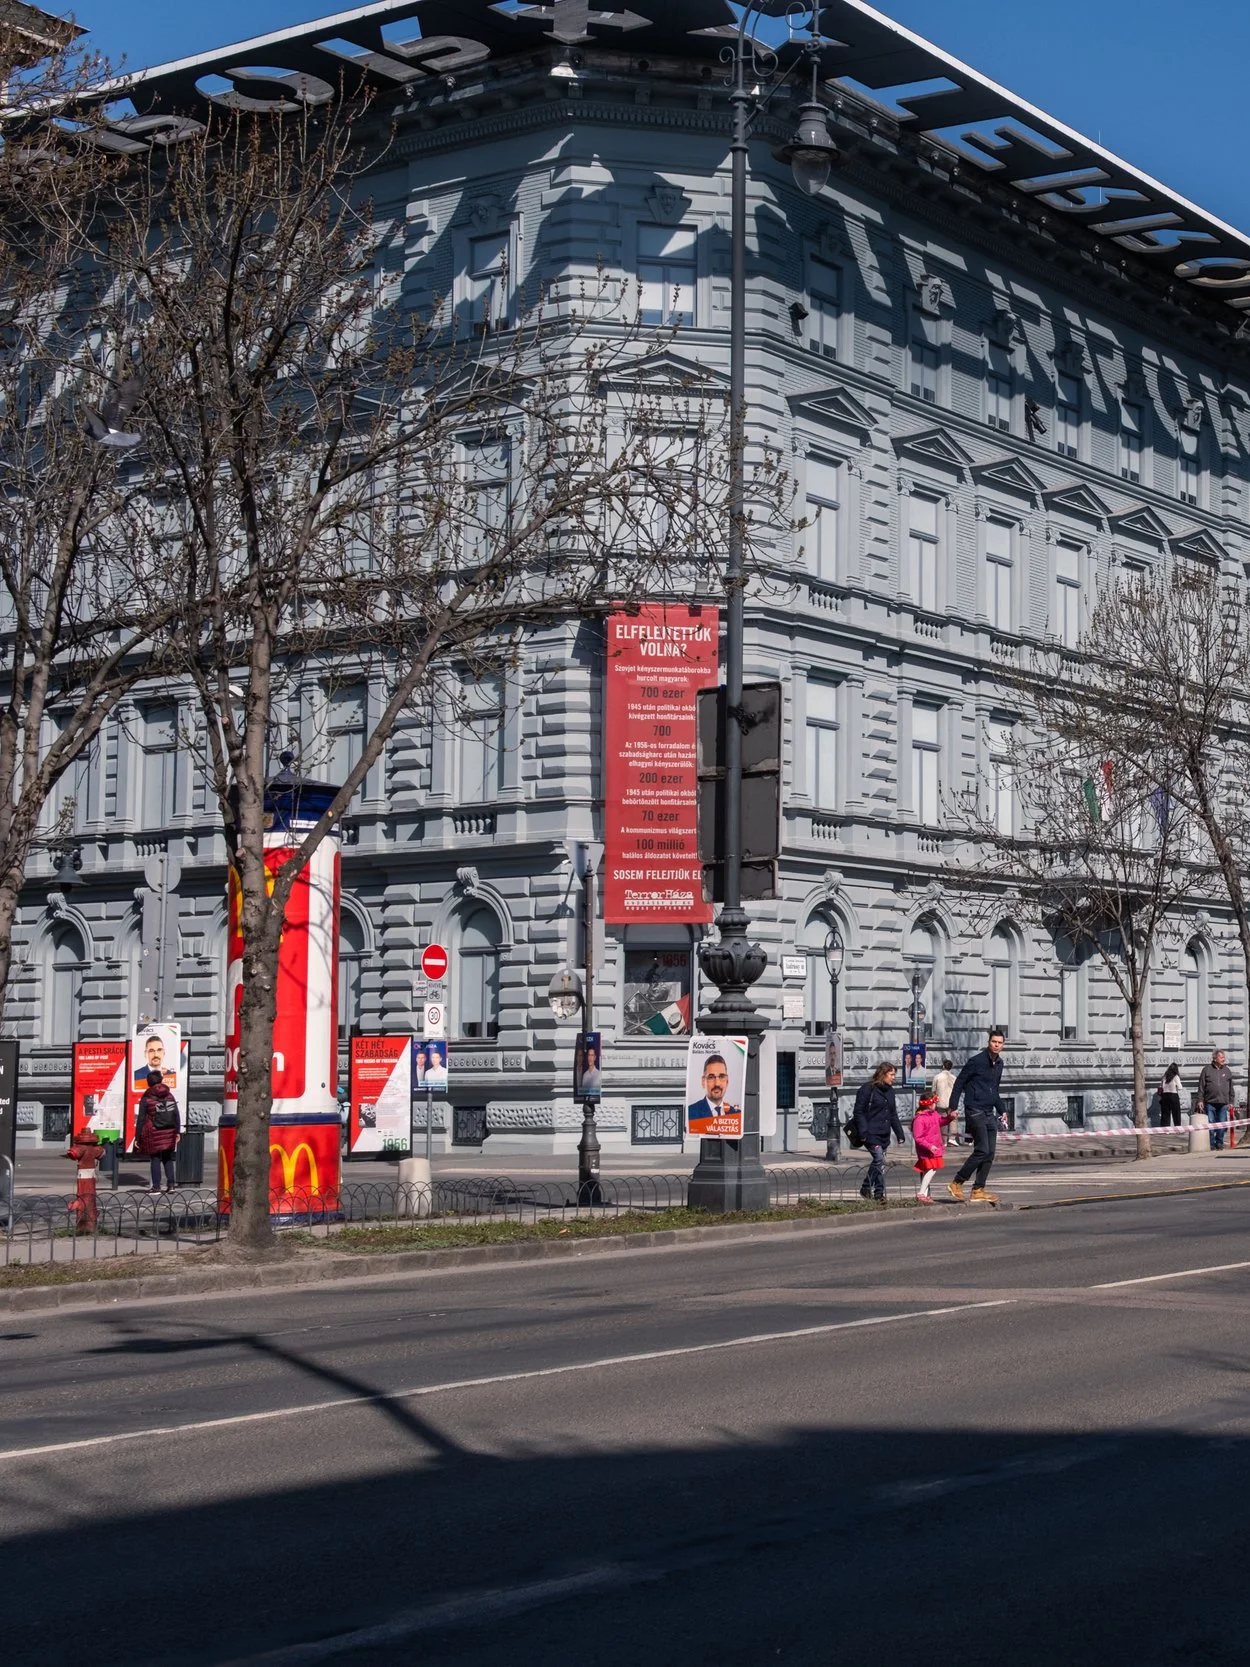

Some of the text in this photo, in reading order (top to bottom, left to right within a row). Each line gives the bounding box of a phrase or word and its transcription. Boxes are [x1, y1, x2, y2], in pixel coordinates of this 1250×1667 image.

[640, 642, 688, 657] VOLNA?
[641, 687, 685, 698] 700 ezer
[657, 704, 680, 712] politikai
[682, 704, 697, 712] okbó
[628, 713, 655, 721] kivégzett
[653, 725, 671, 736] 700
[658, 742, 690, 750] forradalom
[639, 773, 684, 784] 200 ezer
[656, 789, 679, 797] politikai
[642, 811, 679, 822] 70 ezer
[669, 827, 697, 835] világszert
[636, 839, 685, 850] 100 millió
[613, 870, 644, 880] SOSEM
[646, 869, 690, 880] FELEJTJÜK
[430, 1011, 438, 1021] 30
[355, 1039, 385, 1049] KÉT HÉT
[692, 1041, 716, 1050] Kovács
[78, 1046, 125, 1055] A PESTI SRÁCO
[355, 1048, 398, 1058] SZABADSÁG
[706, 1124, 739, 1132] VÁLASZTÁS
[382, 1138, 408, 1150] 1956
